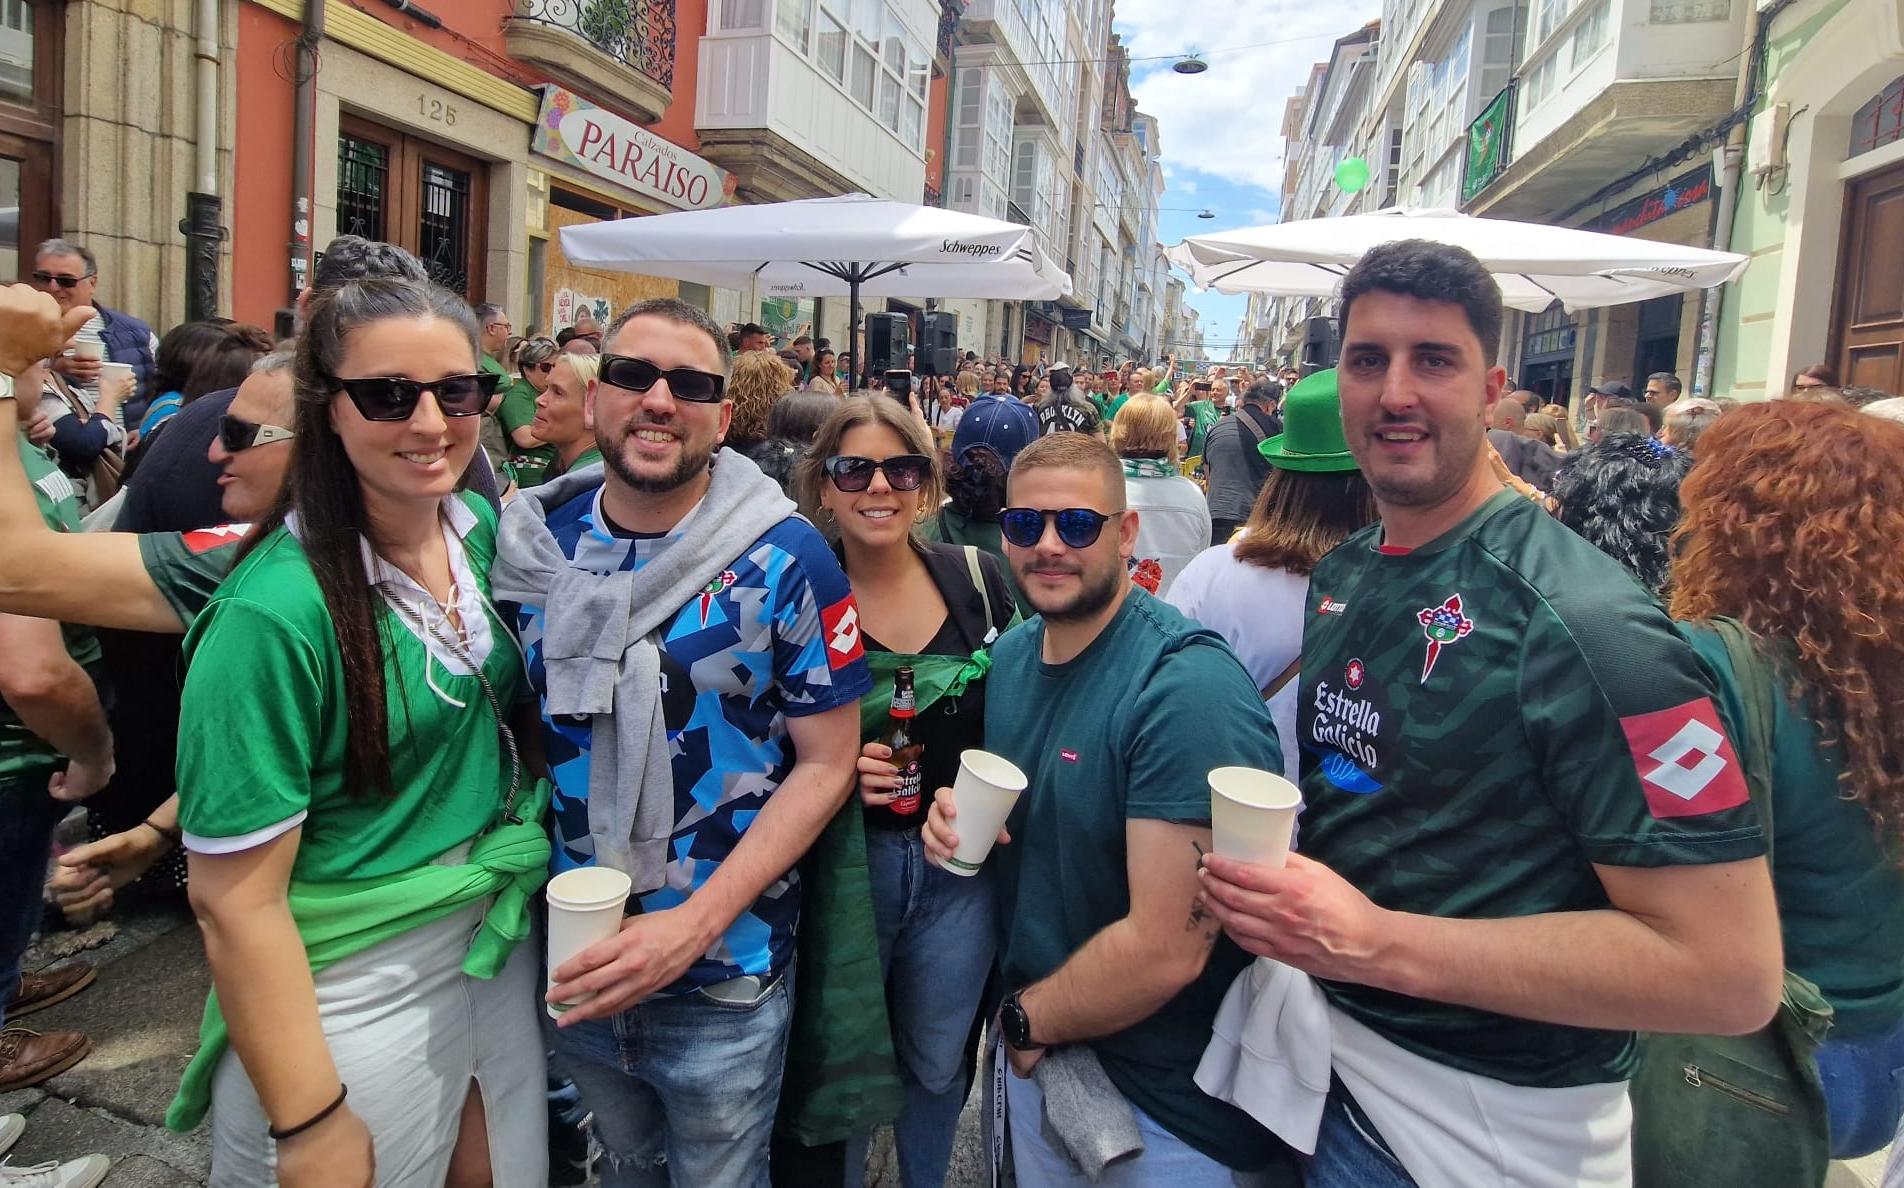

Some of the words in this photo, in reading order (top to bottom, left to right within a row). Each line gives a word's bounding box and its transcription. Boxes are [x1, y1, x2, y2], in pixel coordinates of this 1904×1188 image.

[417, 94, 457, 126] 125
[634, 130, 678, 161] Calzados
[576, 118, 708, 206] PARAISO
[939, 239, 1001, 256] Schweppes
[1040, 405, 1085, 427] BROKLYN
[1314, 681, 1380, 737] Estrella
[1312, 712, 1377, 769] Galicia
